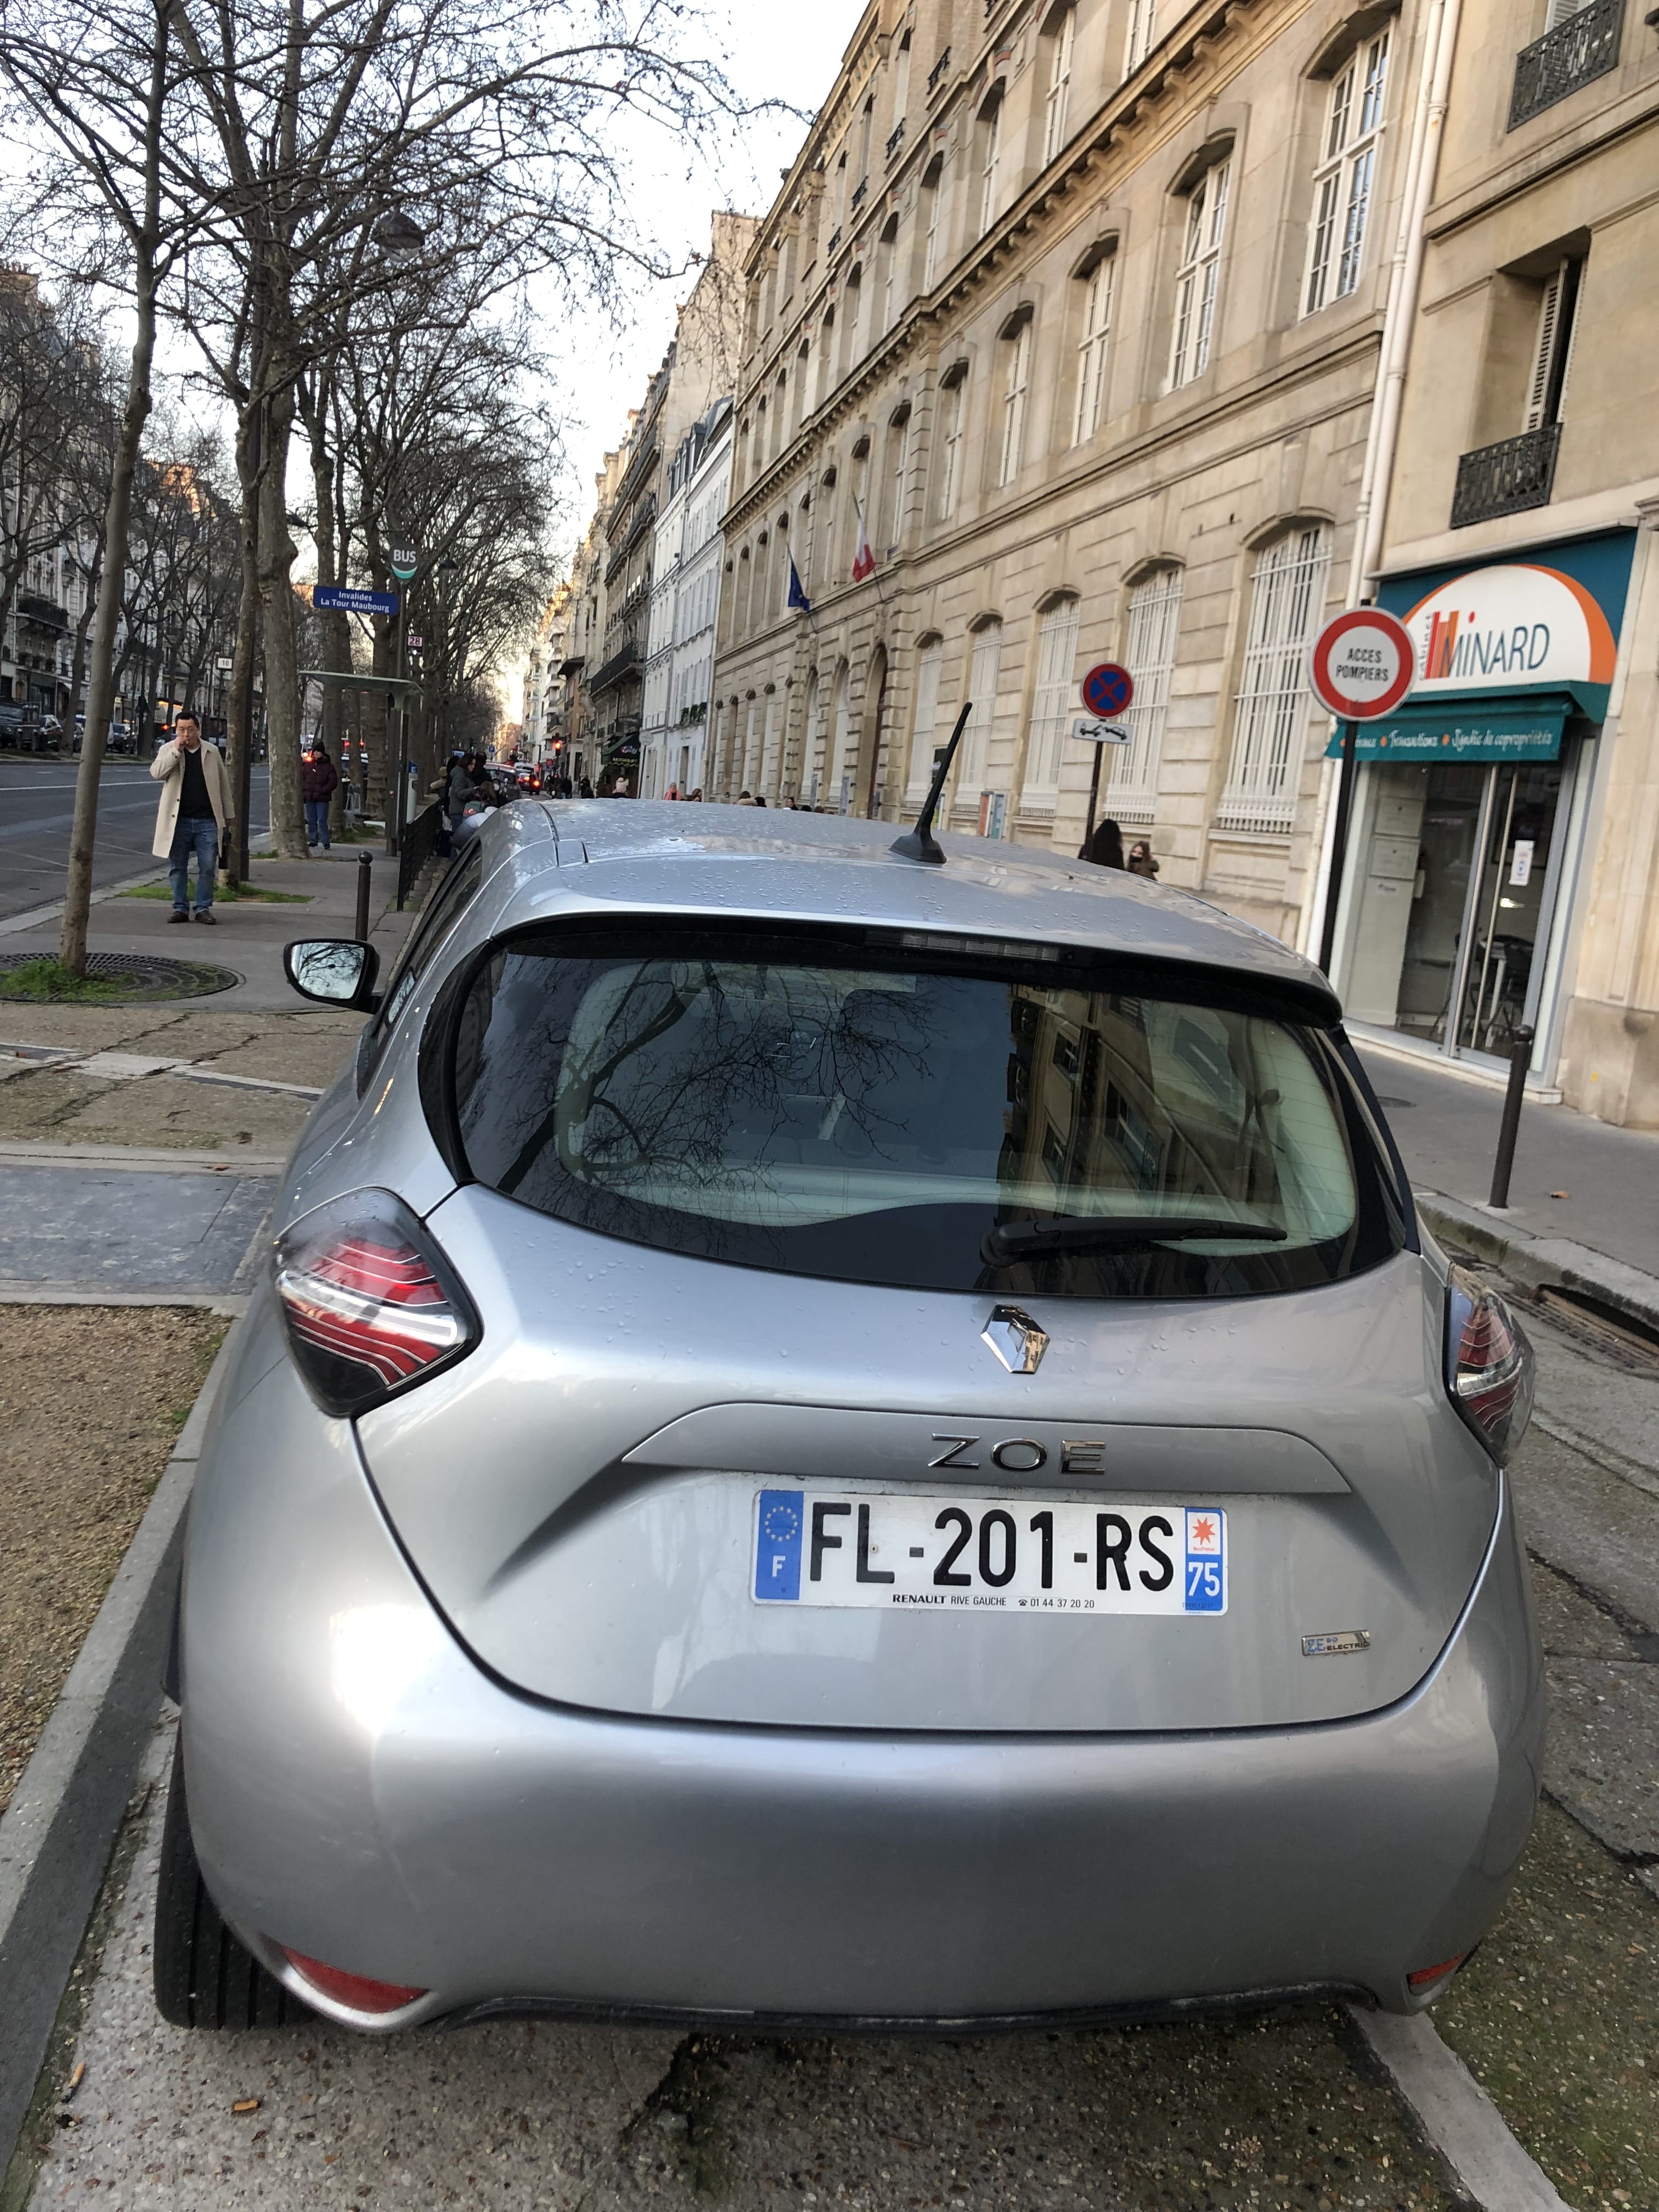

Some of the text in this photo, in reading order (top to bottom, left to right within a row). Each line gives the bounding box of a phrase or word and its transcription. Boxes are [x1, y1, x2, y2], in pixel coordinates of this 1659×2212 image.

[393, 549, 416, 563] BUS
[338, 591, 373, 601] Invalides
[320, 597, 390, 614] La Tour Maubourg
[409, 637, 420, 646] 28
[1347, 648, 1382, 663] ACCES
[1335, 664, 1389, 681] POMPIERS
[927, 1432, 1107, 1475] ZOE
[809, 1502, 1174, 1592] FL-201-RS
[772, 1555, 787, 1578] F
[1188, 1561, 1220, 1597] 75
[893, 1594, 1094, 1609] RENAULT RIVE GAUCHE 01 44 37 20 20
